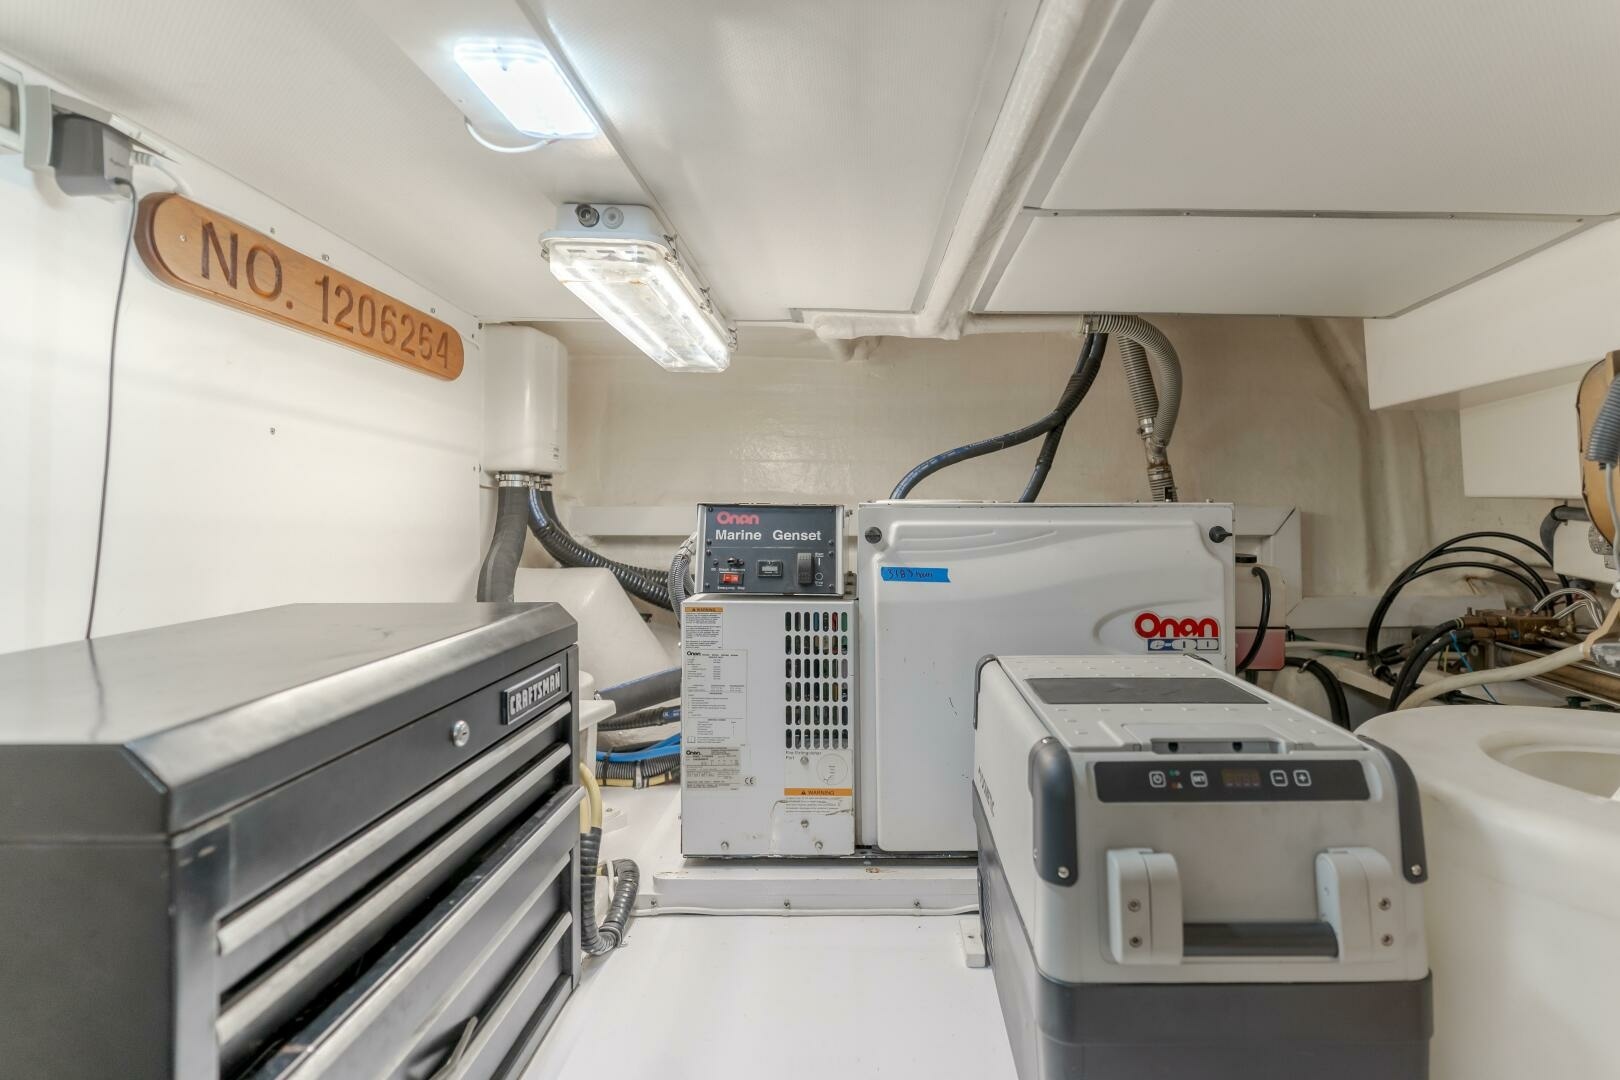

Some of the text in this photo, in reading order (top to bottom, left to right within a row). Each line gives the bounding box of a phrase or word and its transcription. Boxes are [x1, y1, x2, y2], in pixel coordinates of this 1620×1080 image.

[201, 219, 450, 369] NO. 1206254
[716, 510, 760, 525] Onan
[715, 528, 822, 541] Marine Genset
[1134, 612, 1219, 639] Onan
[509, 670, 561, 717] CRAFTSMAN
